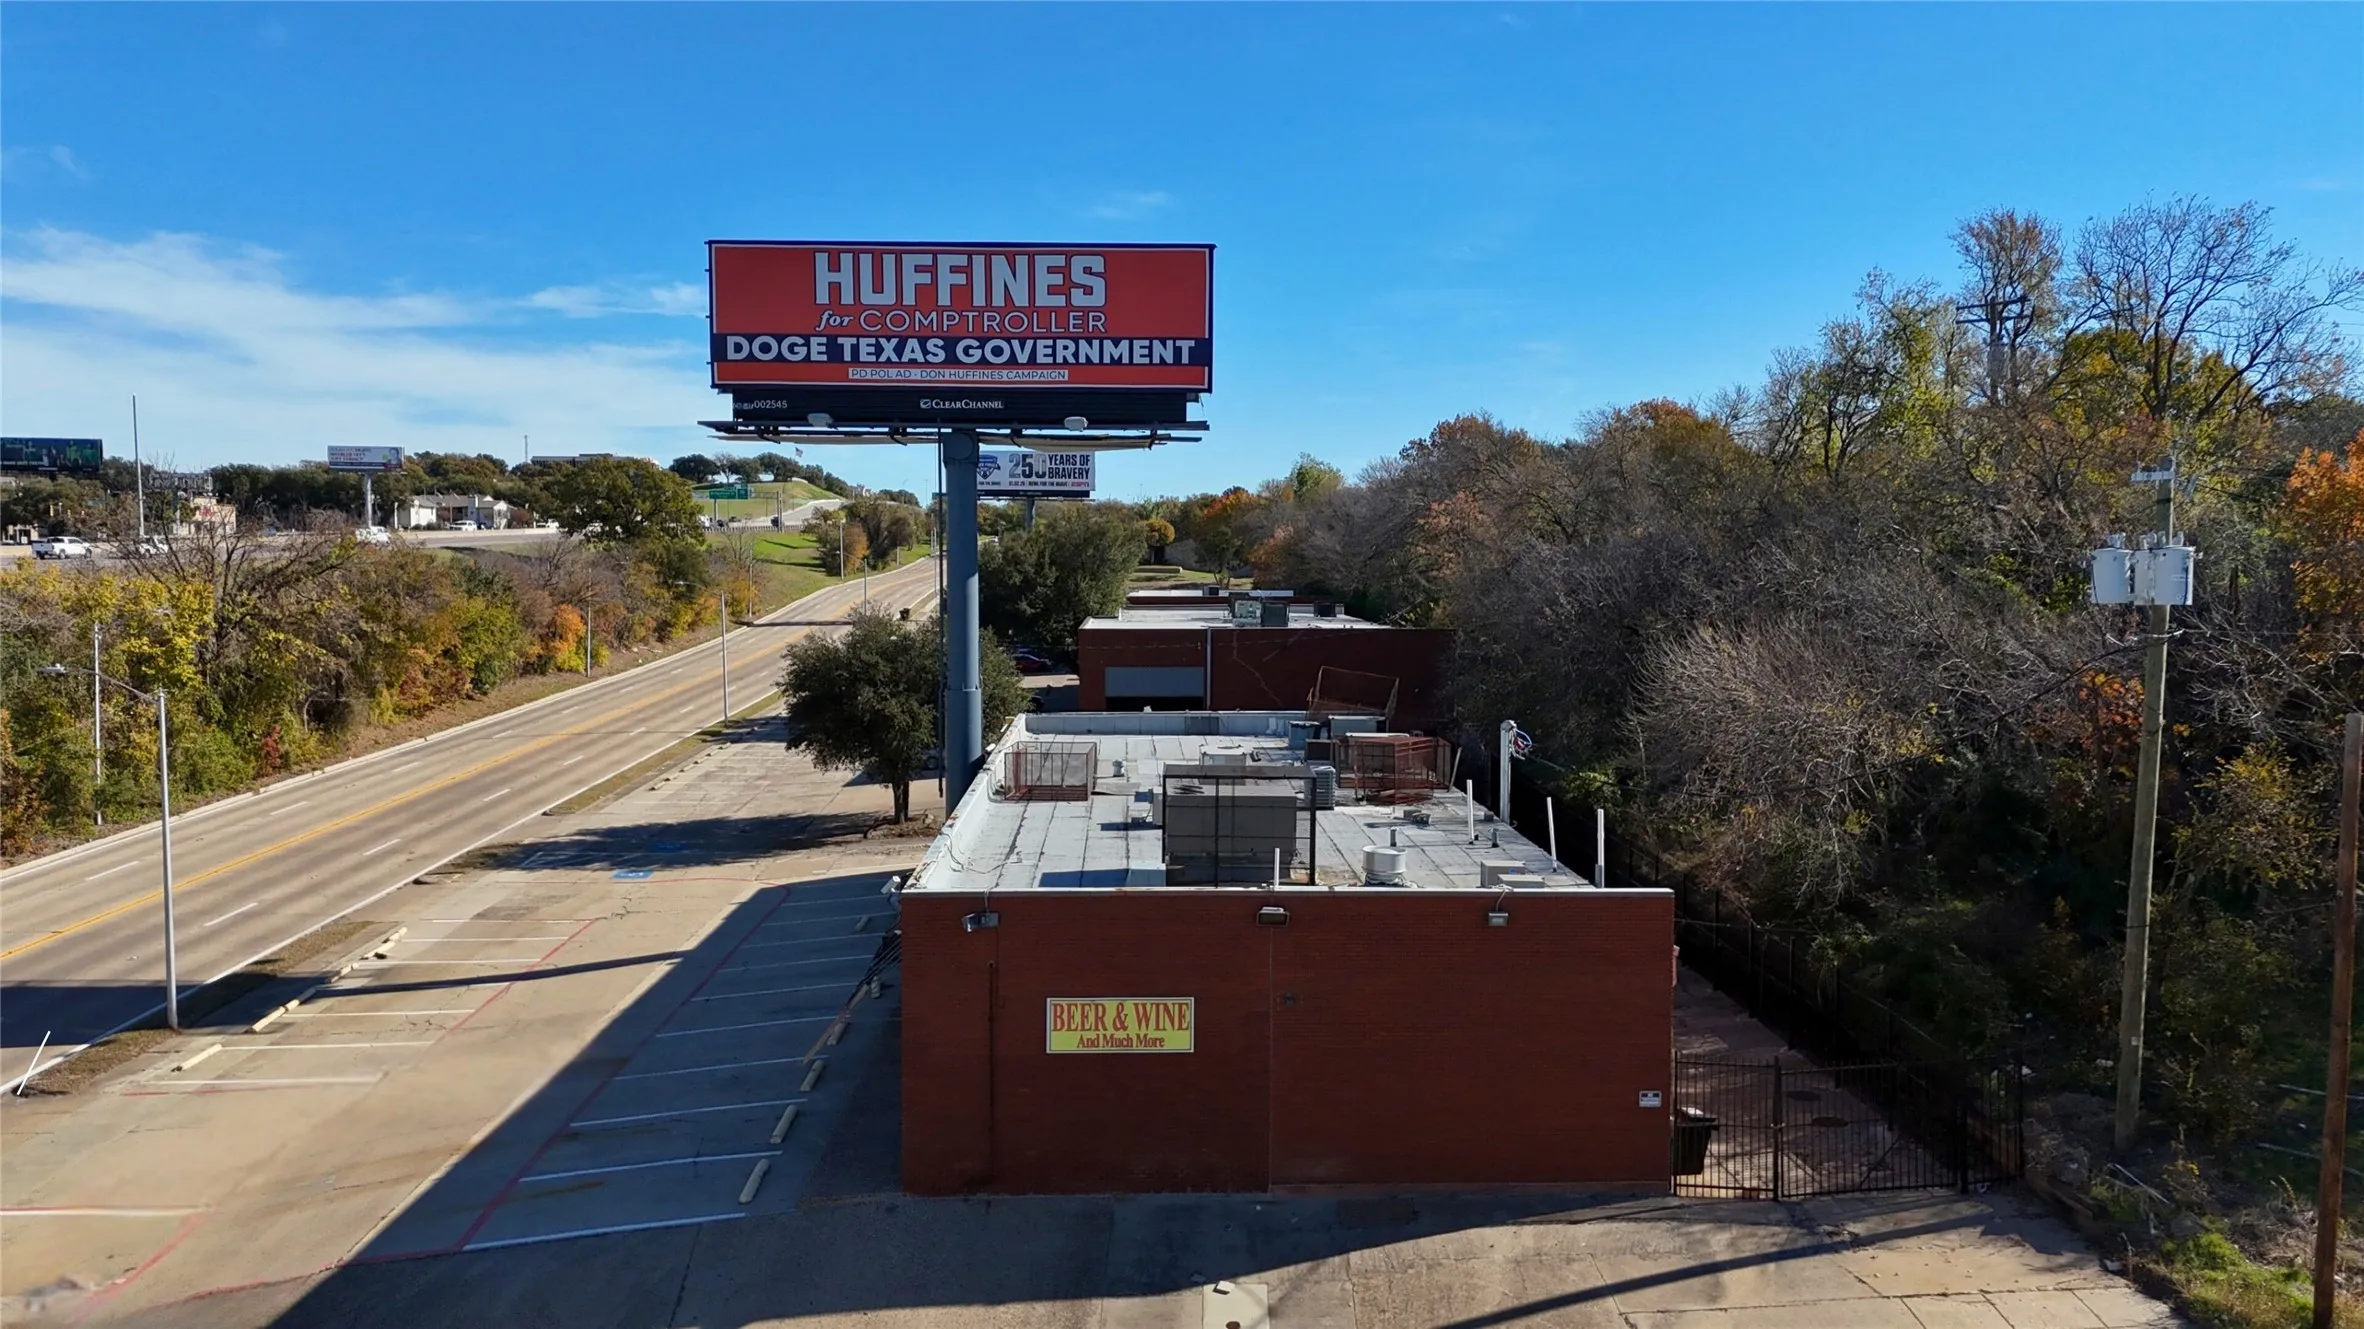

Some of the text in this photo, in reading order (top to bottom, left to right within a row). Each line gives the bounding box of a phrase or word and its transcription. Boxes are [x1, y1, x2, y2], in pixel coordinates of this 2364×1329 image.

[813, 252, 1107, 307] HUFFINES
[816, 310, 1107, 333] for COMPTROLLER
[726, 335, 1196, 365] DOGE TEXAS GOVERNMENT
[851, 369, 868, 379] PD
[870, 369, 894, 379] POL
[895, 369, 911, 379] AD
[920, 369, 945, 379] DON
[948, 369, 1004, 380] HUFFINES
[1006, 370, 1066, 380] CAMPAIGN
[754, 399, 787, 409] 002545
[1048, 454, 1077, 466] YEARS
[1079, 454, 1090, 466] OF
[1048, 467, 1090, 480] BRAVERY
[1052, 1002, 1190, 1032] BEER & WINE
[1077, 1034, 1165, 1049] And Much More
